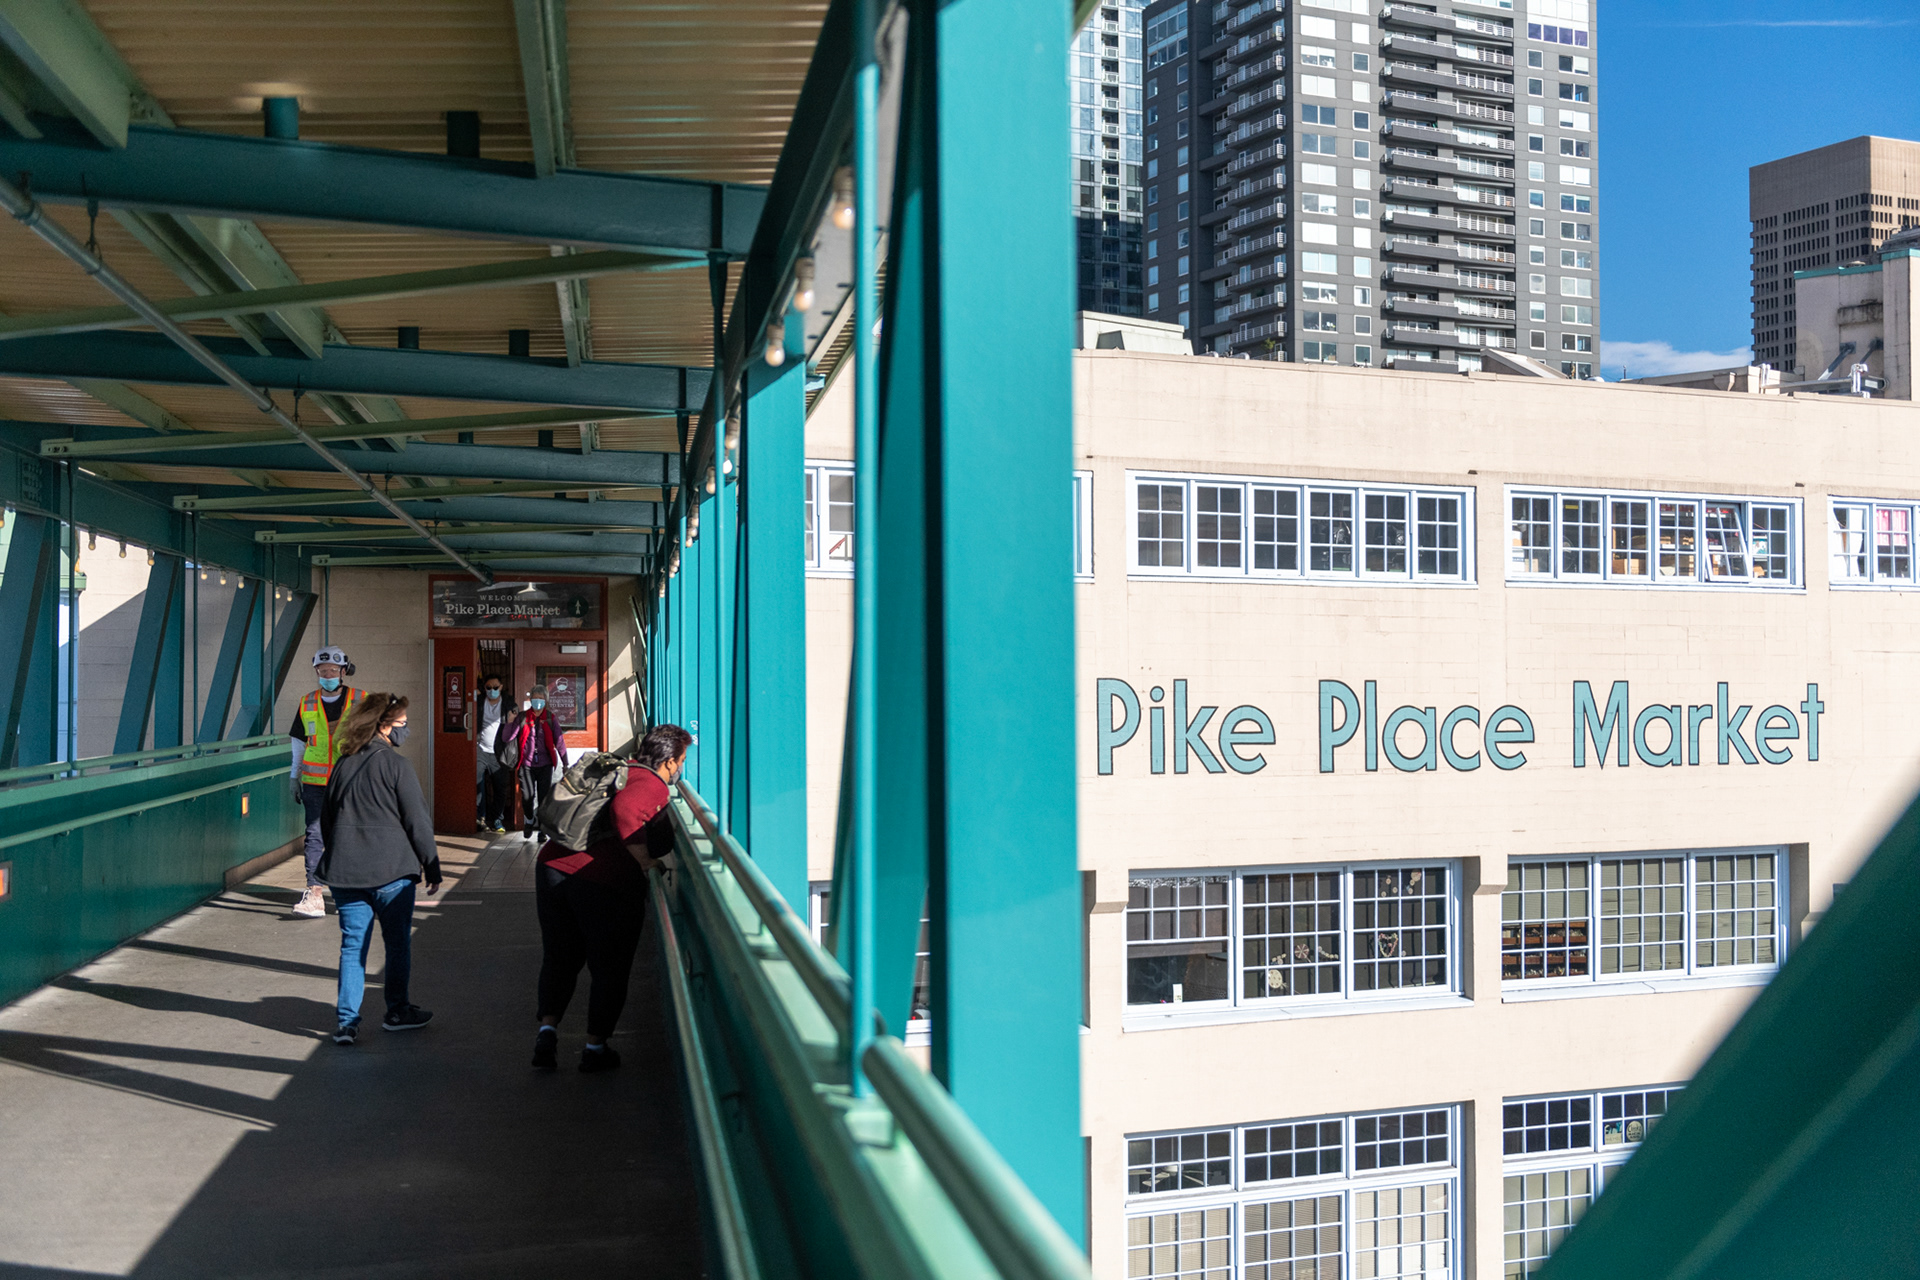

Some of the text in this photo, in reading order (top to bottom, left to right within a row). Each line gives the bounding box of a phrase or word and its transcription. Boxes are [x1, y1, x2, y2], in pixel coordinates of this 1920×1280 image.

[445, 603, 560, 615] Pike Place Market
[1096, 678, 1825, 775] Pike Place Market
